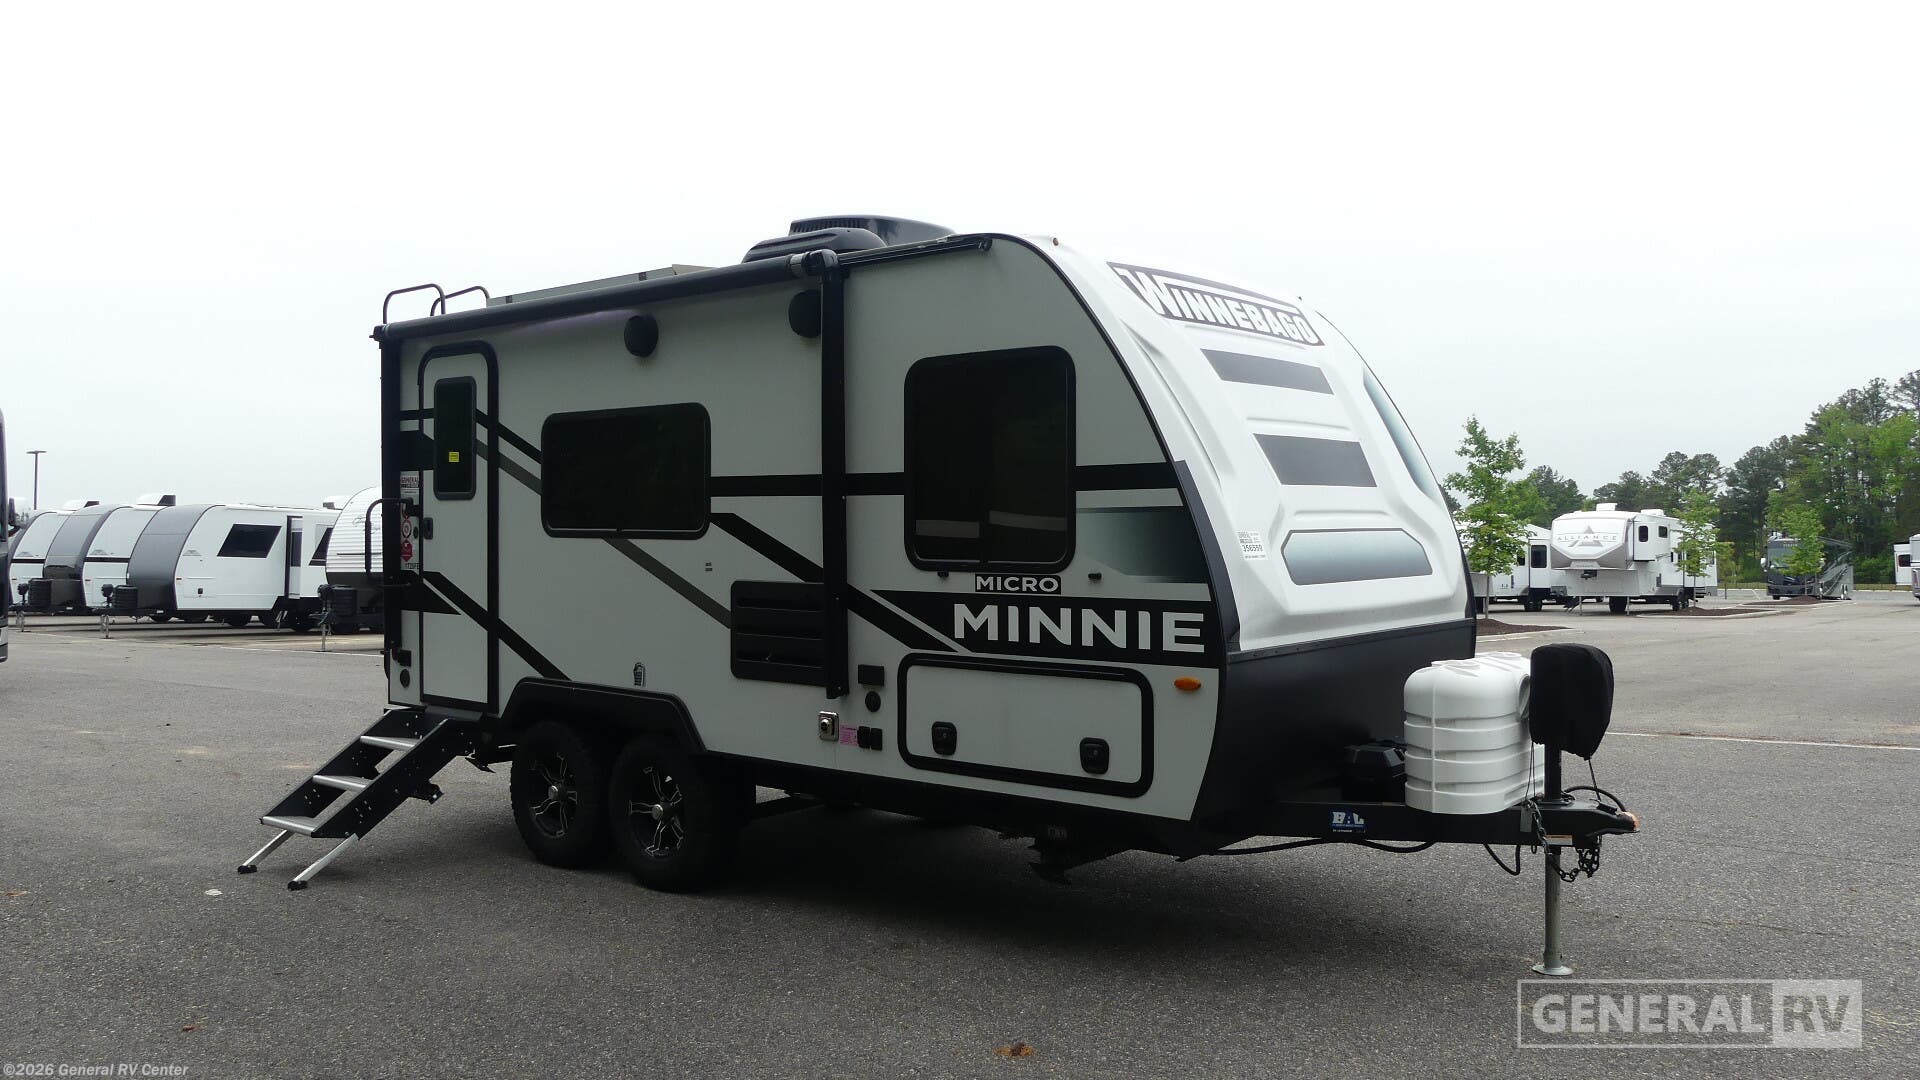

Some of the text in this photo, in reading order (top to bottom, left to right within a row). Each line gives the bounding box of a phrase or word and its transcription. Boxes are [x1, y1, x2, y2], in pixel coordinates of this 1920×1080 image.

[1112, 266, 1320, 345] WINNEBAGO
[976, 576, 1059, 593] MICRO
[953, 603, 1205, 653] MINNIE
